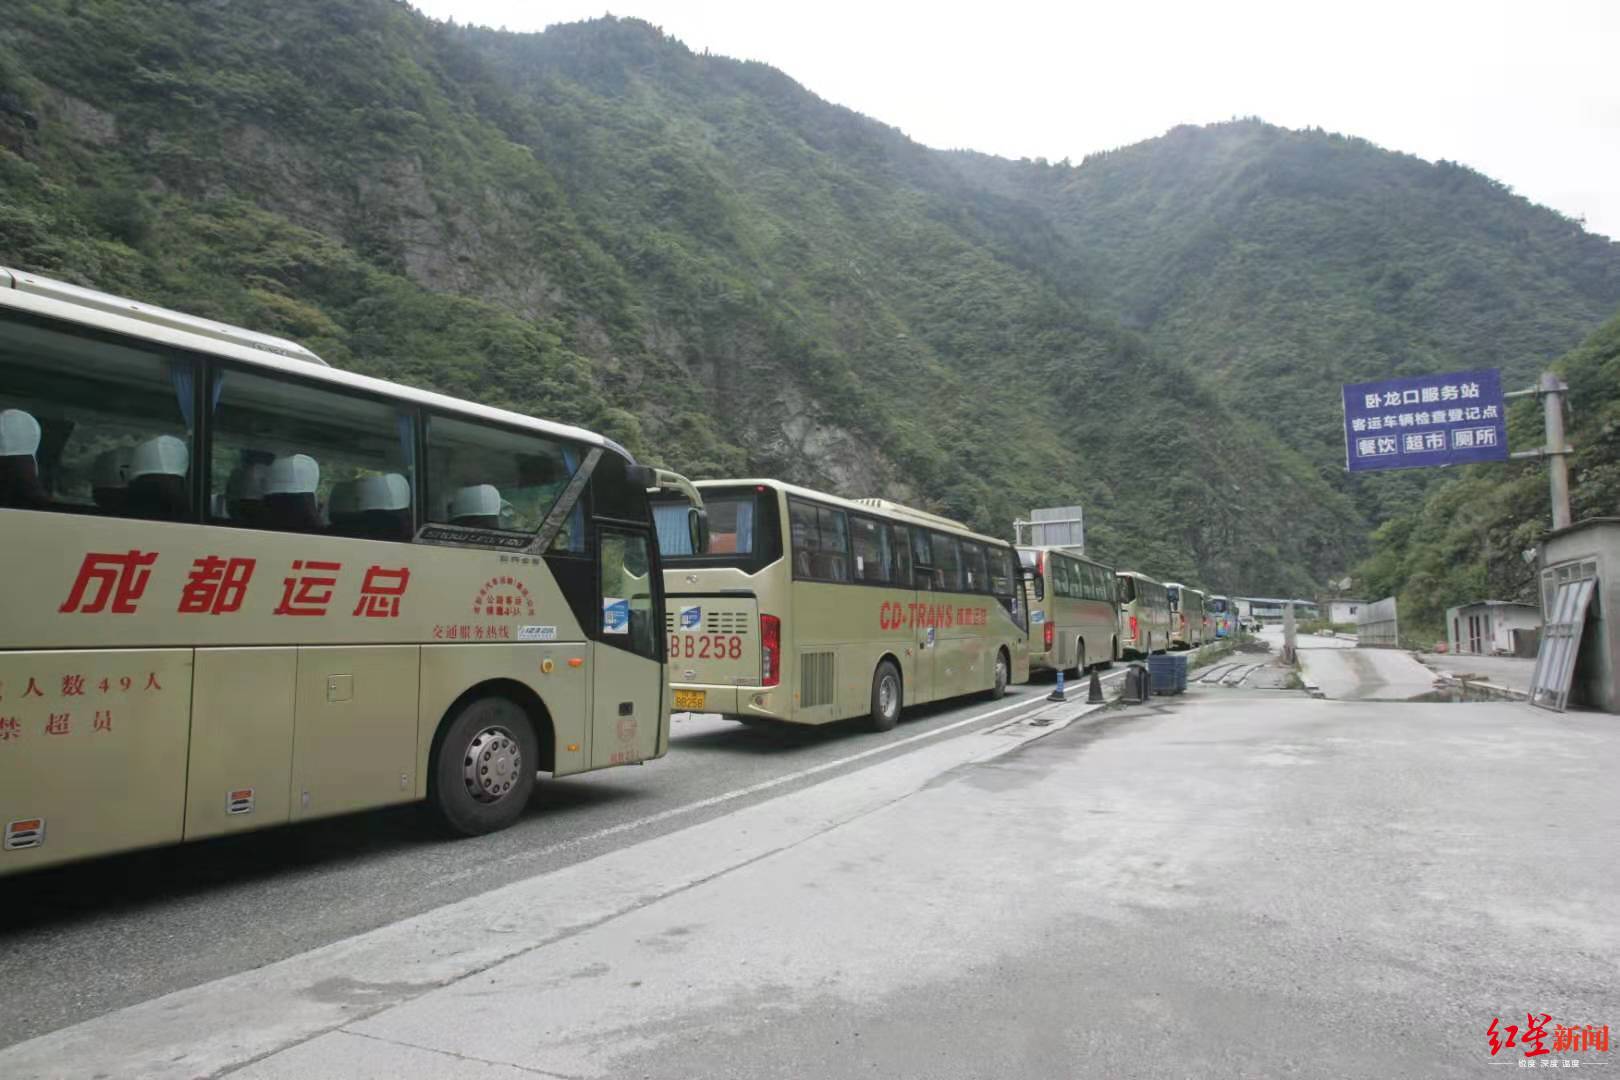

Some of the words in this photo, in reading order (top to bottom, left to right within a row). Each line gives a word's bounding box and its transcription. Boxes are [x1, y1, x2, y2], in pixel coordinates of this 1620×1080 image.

[1364, 382, 1480, 409] 卧龙口服务站
[1359, 438, 1395, 455] 餐饮
[1405, 433, 1444, 451] 超市
[1455, 428, 1495, 447] 厕所
[58, 550, 410, 617] 成都运总
[432, 624, 510, 639] 交通服务热线
[0, 672, 161, 699] 人数49人
